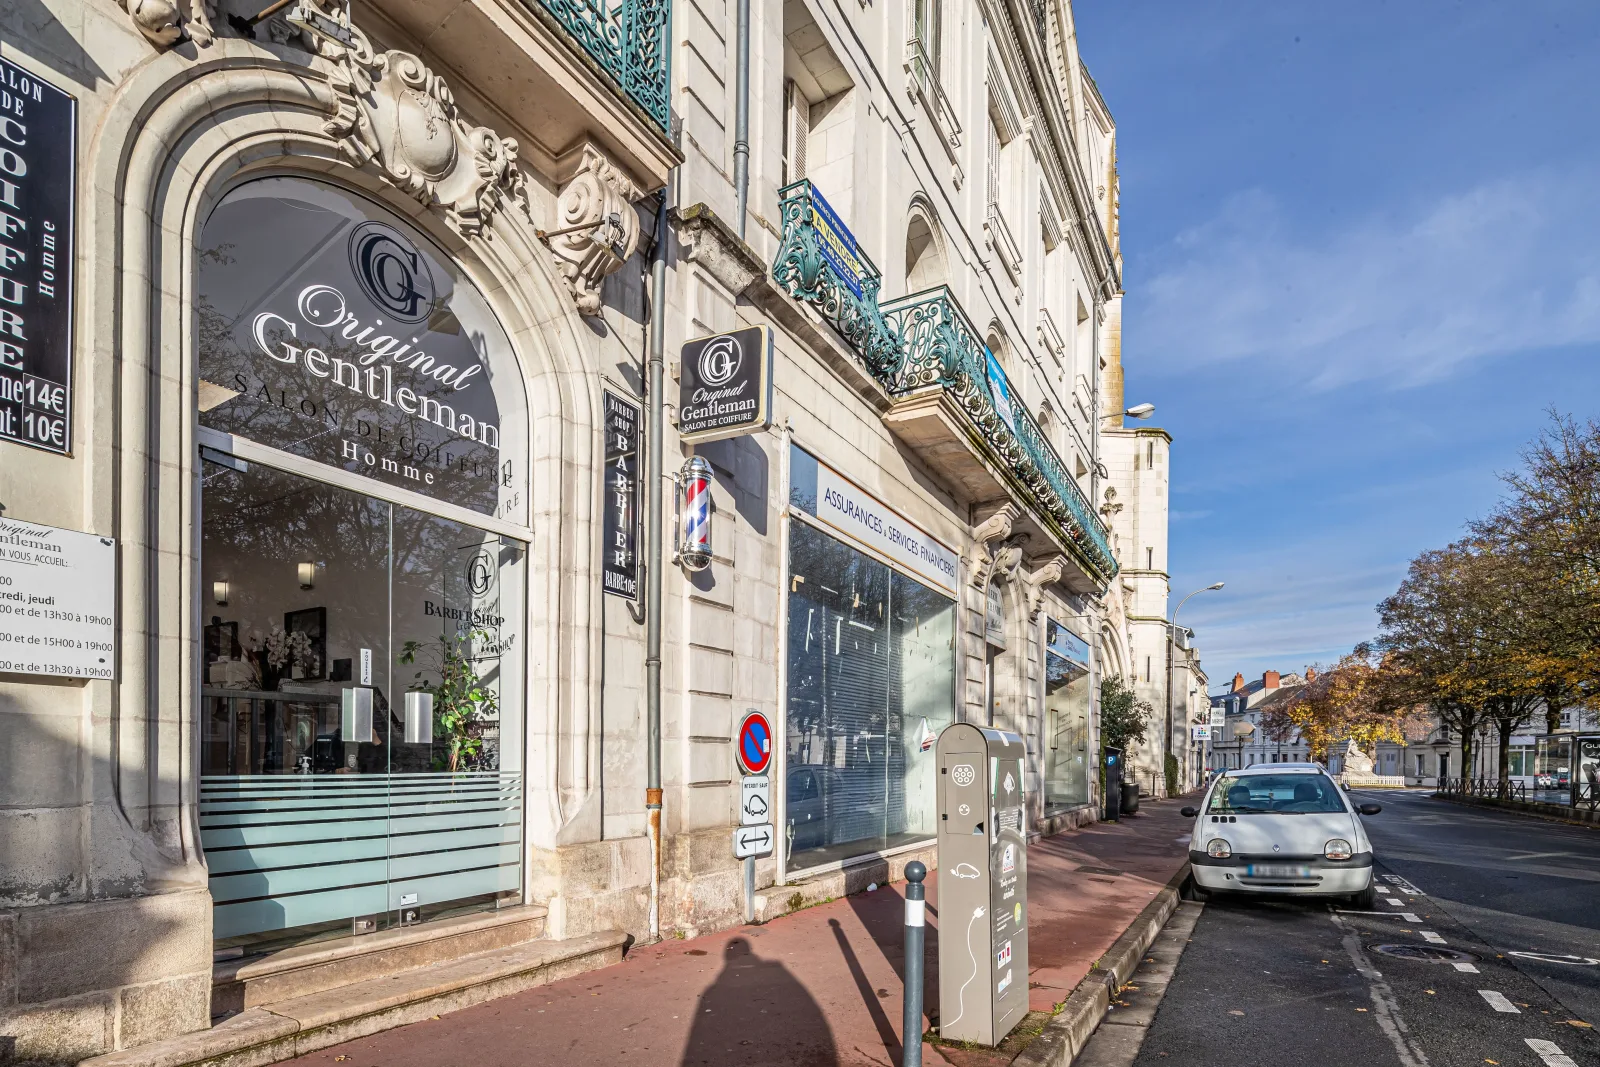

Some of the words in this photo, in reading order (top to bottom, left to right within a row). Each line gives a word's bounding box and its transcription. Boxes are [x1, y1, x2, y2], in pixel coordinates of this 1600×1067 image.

[1, 90, 24, 117] DE
[39, 221, 55, 298] Homme
[297, 284, 482, 391] Original
[252, 312, 500, 449] Gentleman
[692, 380, 748, 406] Original
[25, 379, 65, 414] 14€
[234, 373, 338, 426] SALON
[357, 419, 389, 443] DE
[611, 399, 633, 421] BARBER
[681, 398, 756, 422] Gentleman
[684, 421, 706, 432] SALON
[708, 419, 718, 427] DE
[719, 412, 752, 425] COIFFURE
[24, 412, 64, 446] 10€
[615, 416, 629, 432] SHOP
[342, 439, 434, 485] Homme
[615, 434, 628, 568] BARBIER
[824, 487, 883, 534] ASSURANCES
[888, 526, 918, 556] SERVICES
[920, 546, 955, 578] FINANCIERS
[9, 549, 31, 561] VOUS
[34, 554, 68, 567] ACCUEIL:
[605, 570, 625, 590] BARBE
[0, 592, 25, 603] redi,
[28, 594, 55, 605] jeudi
[14, 607, 25, 616] et
[27, 608, 41, 617] de
[43, 610, 73, 622] 13h30
[75, 613, 81, 623] à
[84, 615, 112, 626] 19h00
[14, 635, 25, 643] et
[27, 635, 41, 644] de
[43, 637, 74, 648] 15H00
[76, 640, 82, 649] à
[85, 641, 113, 652] 19h00
[14, 663, 25, 671] et
[27, 663, 40, 672] de
[43, 664, 73, 675] 13h30
[75, 666, 81, 675] à
[84, 667, 112, 677] 19h00
